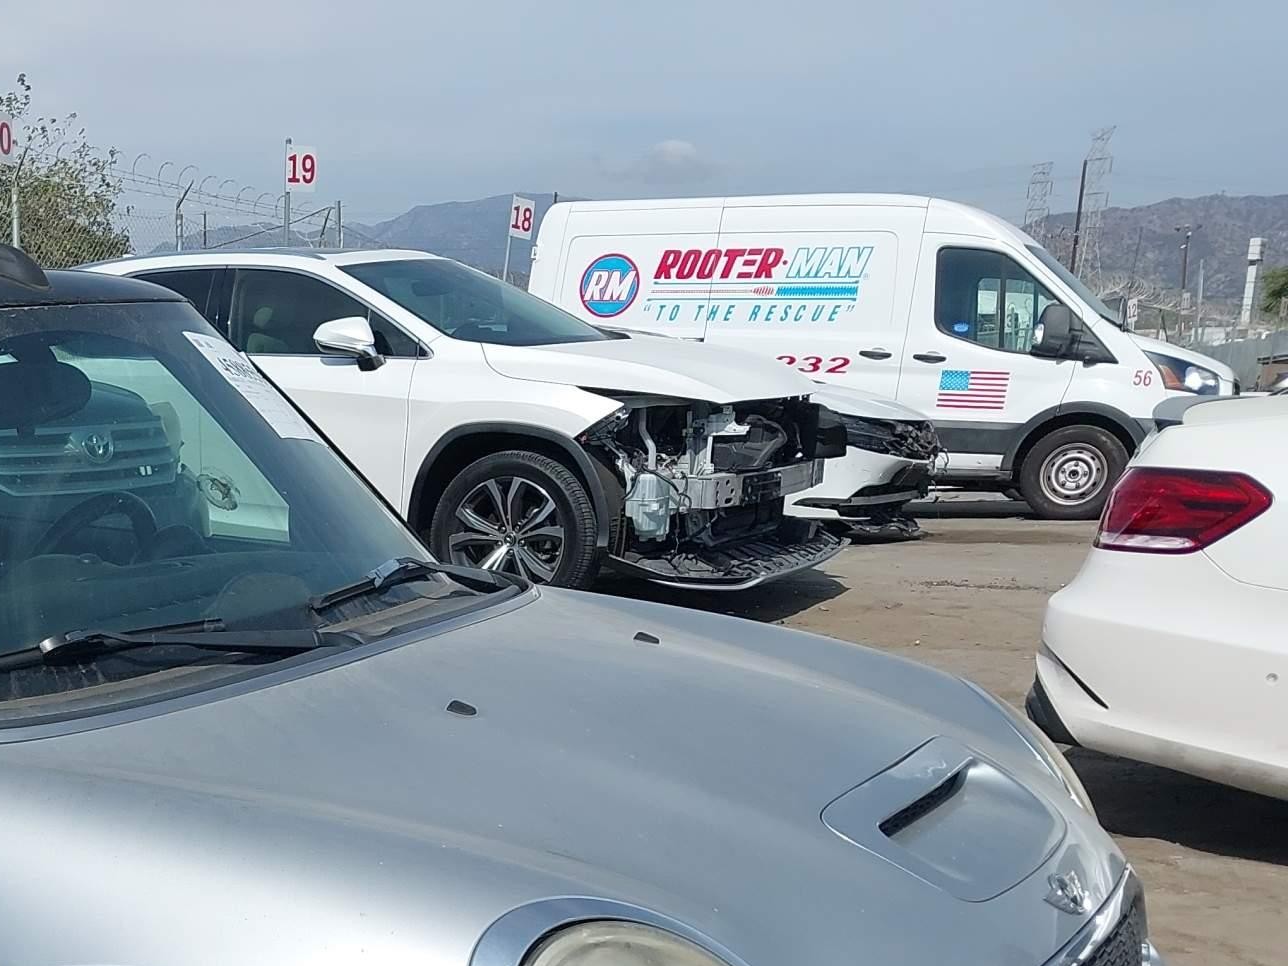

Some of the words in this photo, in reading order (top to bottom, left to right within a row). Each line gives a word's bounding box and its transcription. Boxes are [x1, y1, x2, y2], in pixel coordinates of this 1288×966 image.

[287, 154, 316, 184] 19
[511, 205, 532, 232] 18
[583, 269, 637, 302] RM
[696, 304, 737, 322] THE
[1127, 306, 1137, 320] 12
[1132, 370, 1153, 387] 56
